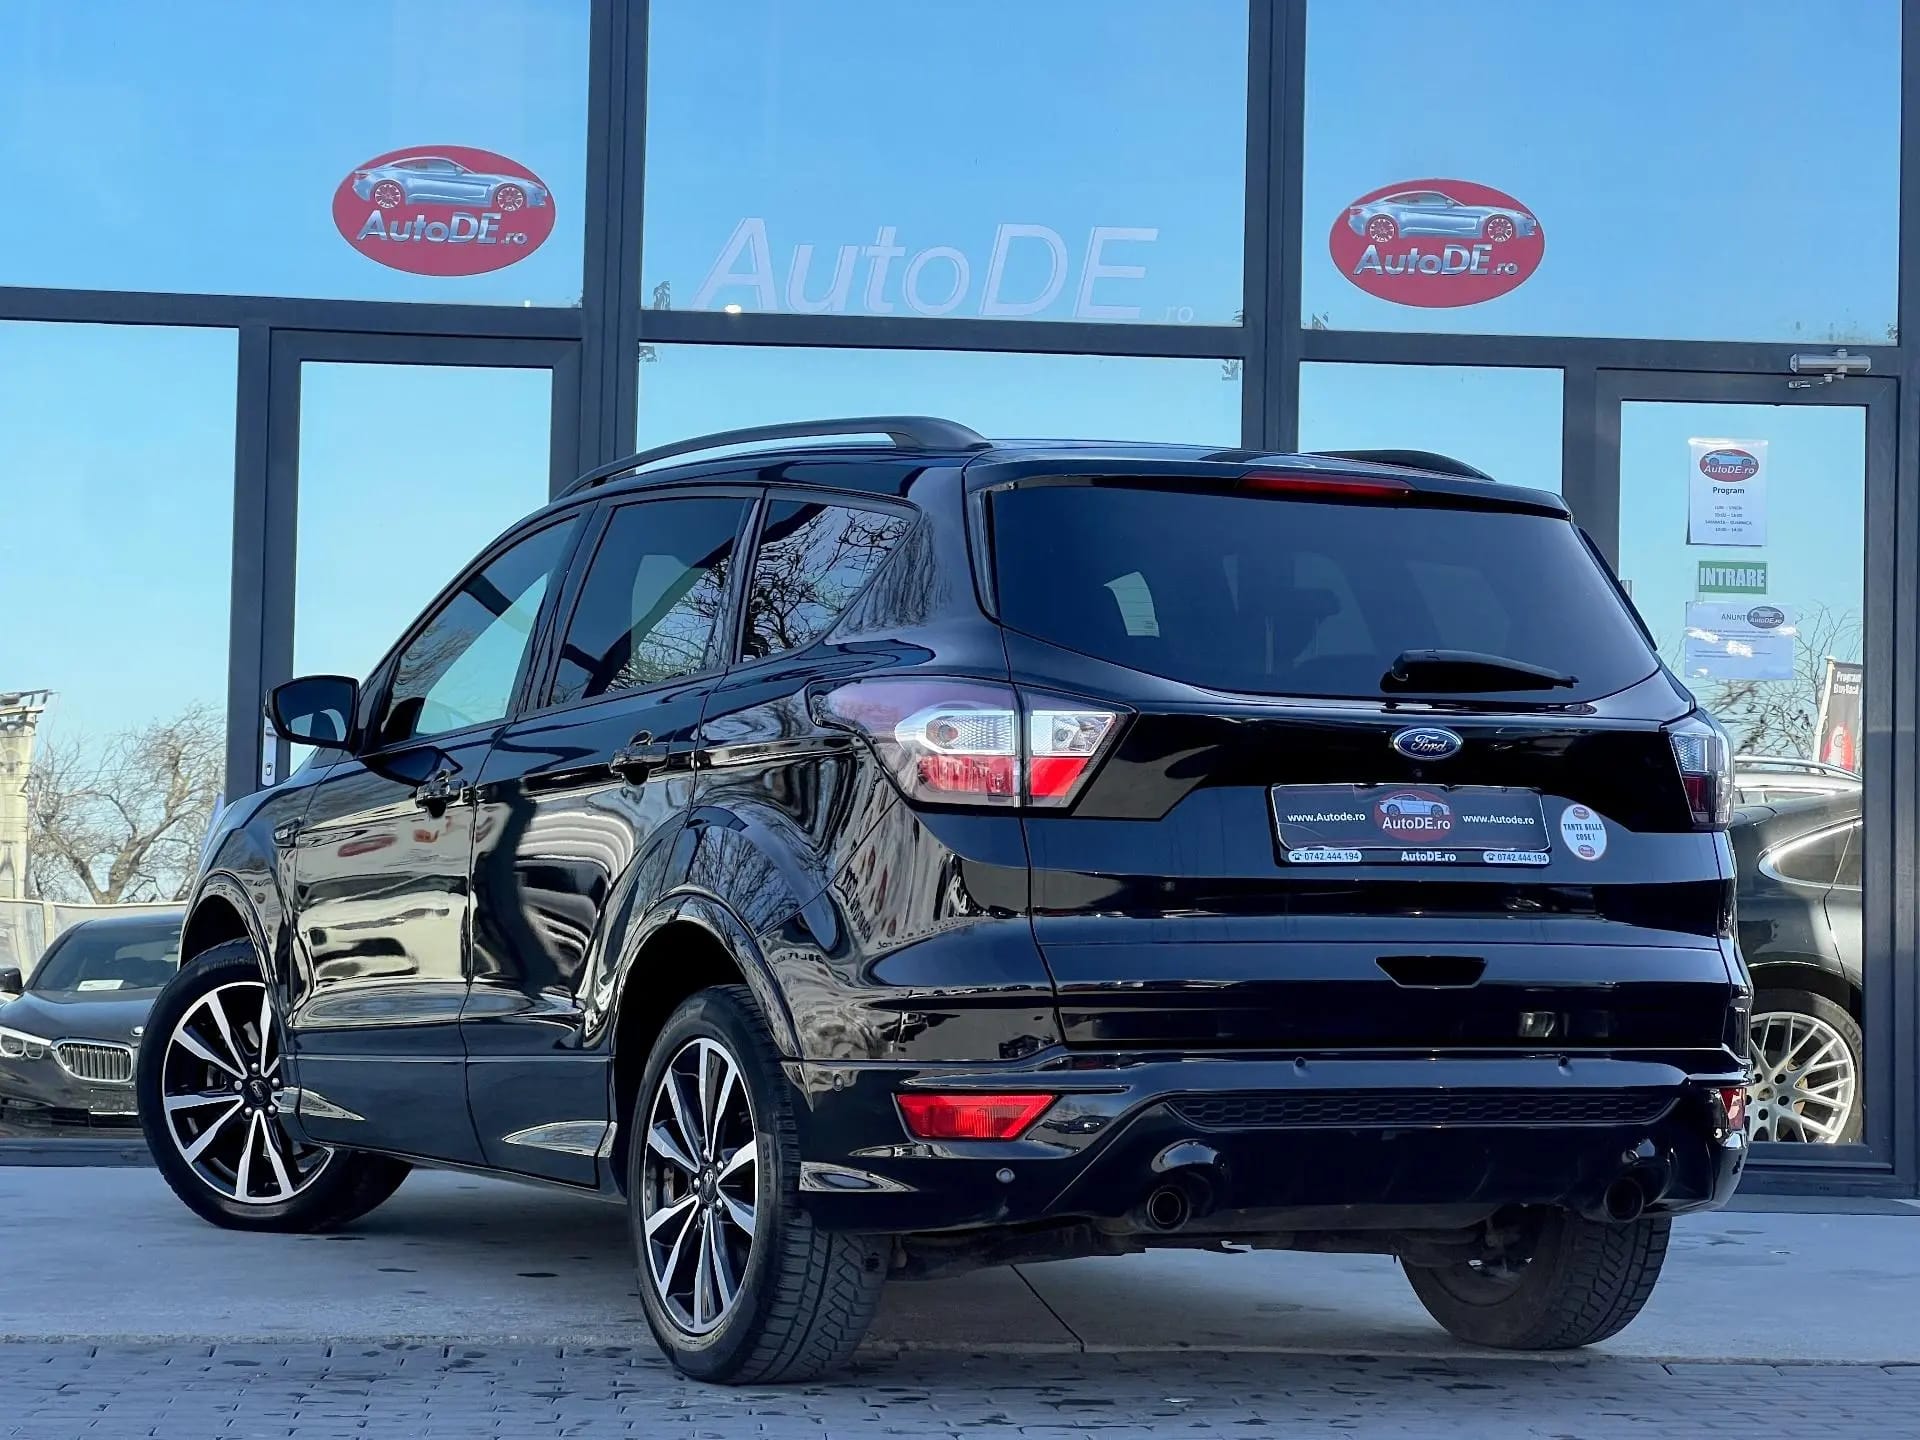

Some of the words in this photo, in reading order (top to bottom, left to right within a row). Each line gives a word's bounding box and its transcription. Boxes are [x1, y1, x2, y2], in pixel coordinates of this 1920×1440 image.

[356, 210, 528, 244] AutoDE.ro
[1352, 243, 1519, 276] AutoDE.ro
[1703, 464, 1756, 475] AutoDE.ro
[1712, 486, 1745, 496] Program
[1700, 567, 1766, 588] INTRARE
[1411, 734, 1448, 752] Ford
[1287, 812, 1366, 822] www.Autode.ro
[1462, 814, 1535, 825] www.Autode.ro
[1382, 816, 1451, 830] AutoDE.ro
[1304, 852, 1359, 861] 0742.444.194
[1400, 851, 1457, 862] AutoDE.ro
